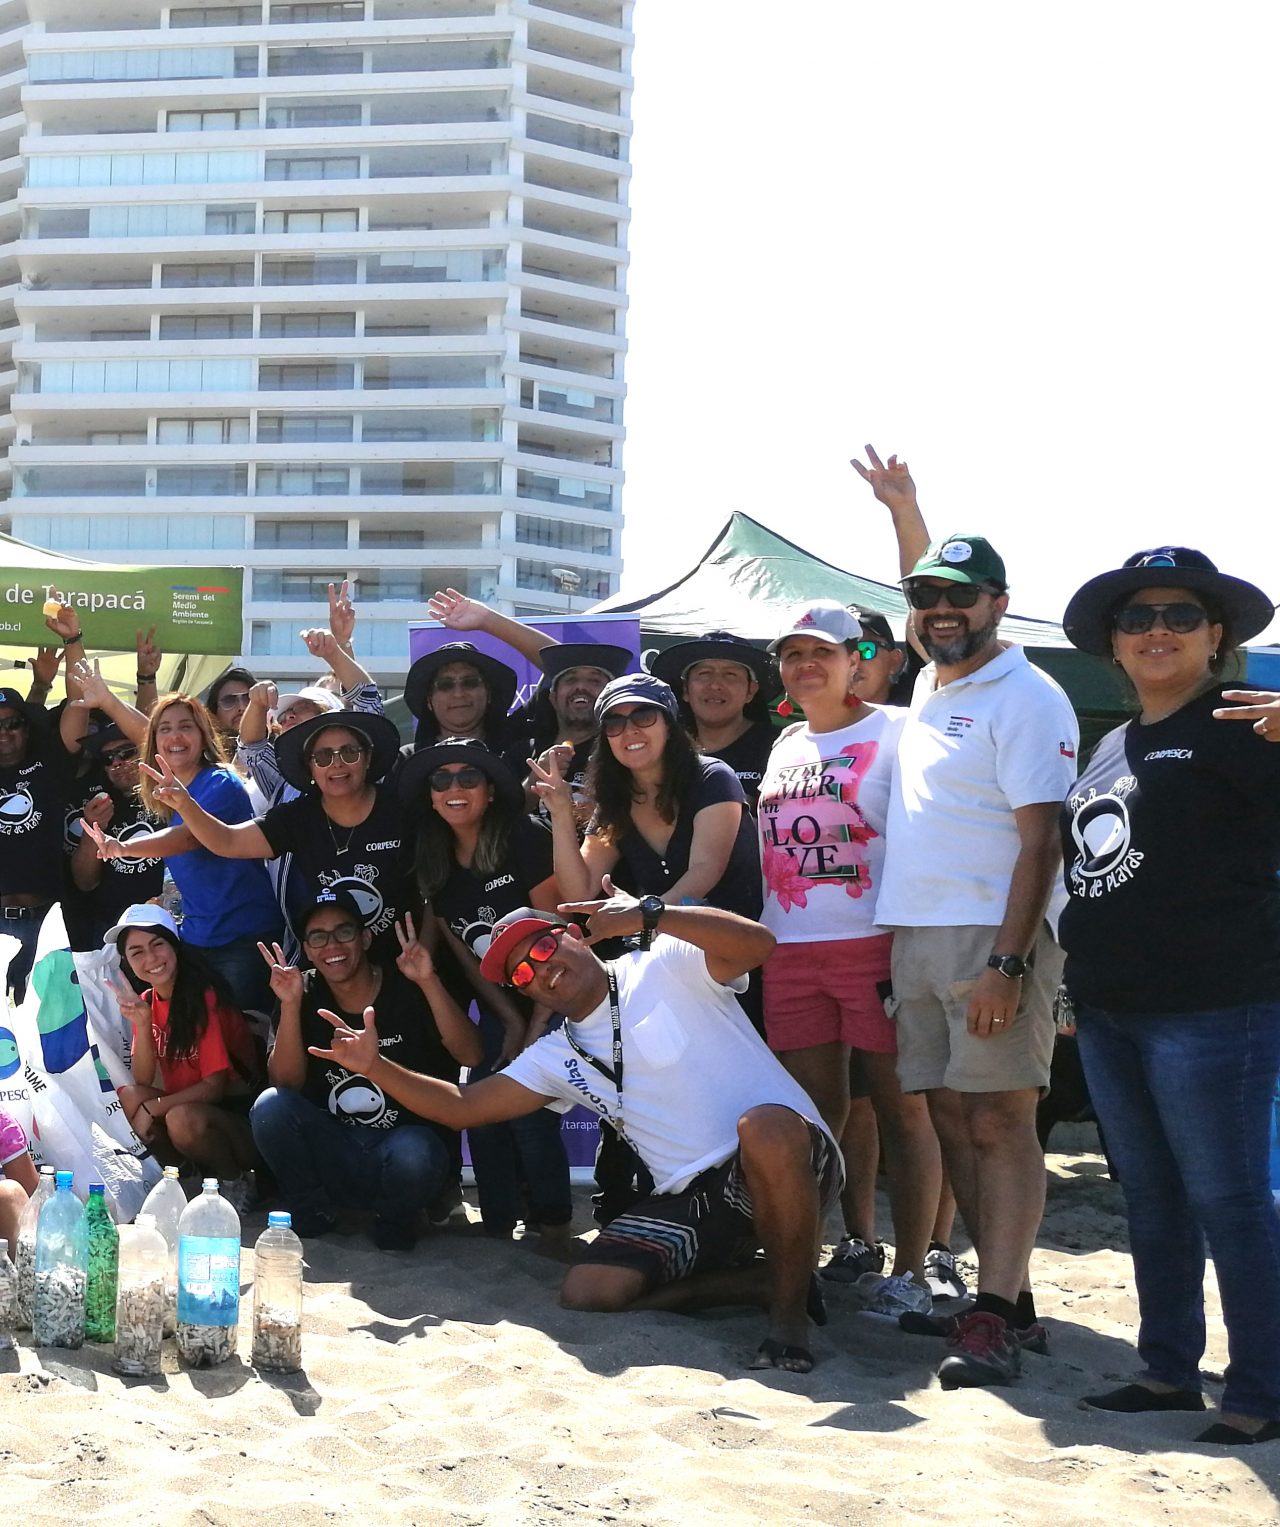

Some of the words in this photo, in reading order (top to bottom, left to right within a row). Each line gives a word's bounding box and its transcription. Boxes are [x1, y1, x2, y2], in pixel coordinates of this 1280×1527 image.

[5, 583, 34, 605] de
[172, 601, 197, 610] Medio
[173, 592, 200, 601] Seremi
[202, 594, 216, 602] del
[172, 610, 209, 619] Ambiente
[768, 815, 821, 846] LO
[785, 845, 839, 876] VE
[1089, 878, 1103, 898] de
[1106, 848, 1145, 893] Playas
[369, 906, 396, 936] Playas
